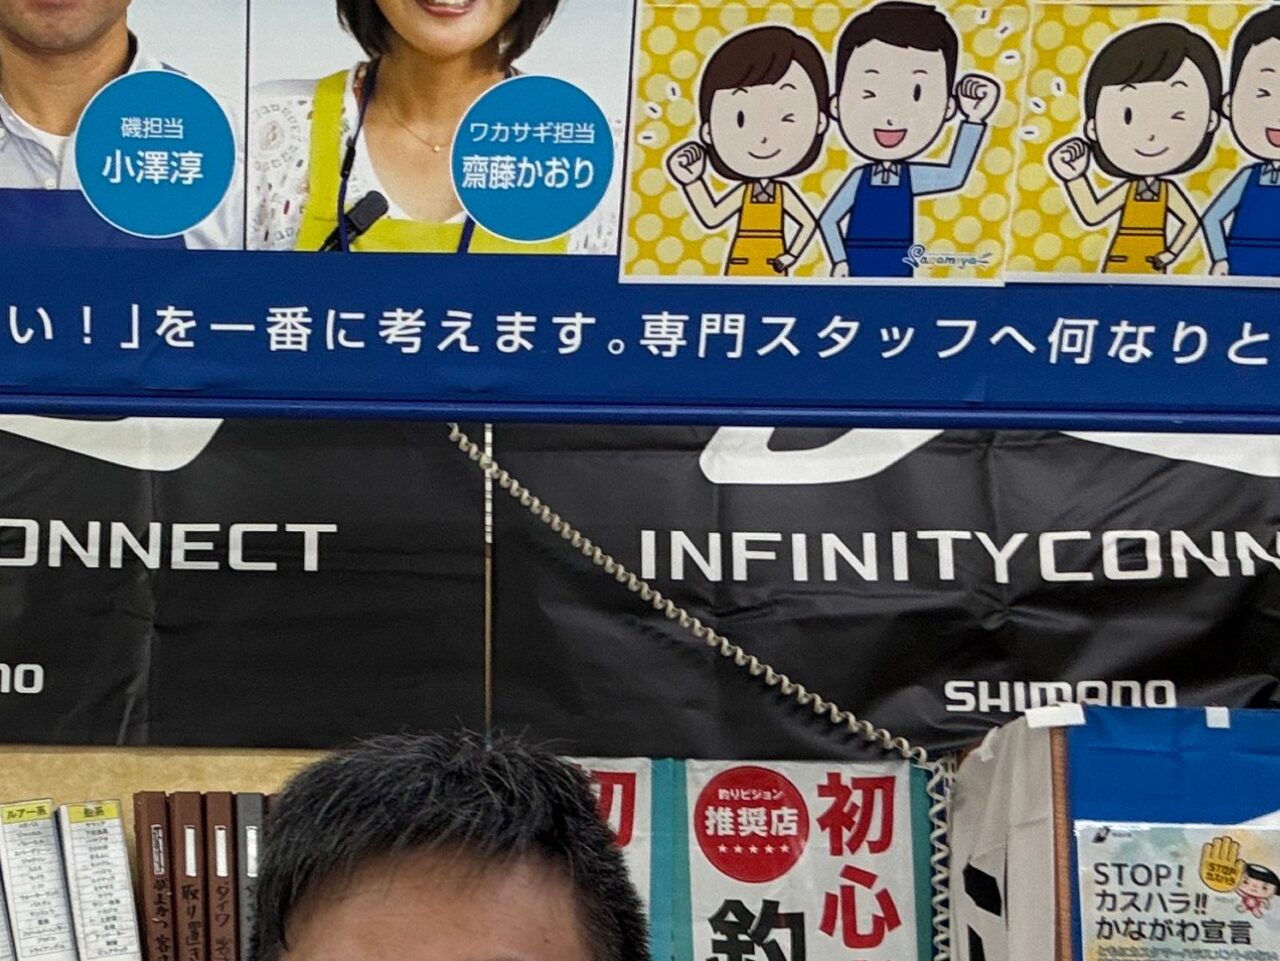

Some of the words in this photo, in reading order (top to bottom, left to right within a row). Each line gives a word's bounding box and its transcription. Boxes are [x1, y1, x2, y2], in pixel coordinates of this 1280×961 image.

[120, 117, 185, 141] 磯担当
[469, 122, 595, 146] ワカサギ担当
[101, 150, 205, 186] 小澤淳
[944, 679, 1176, 712] SHIMANO
[718, 788, 784, 801] 釣りビジョン
[704, 806, 799, 837] 推奨店
[1095, 916, 1254, 945] かながわ宣言
